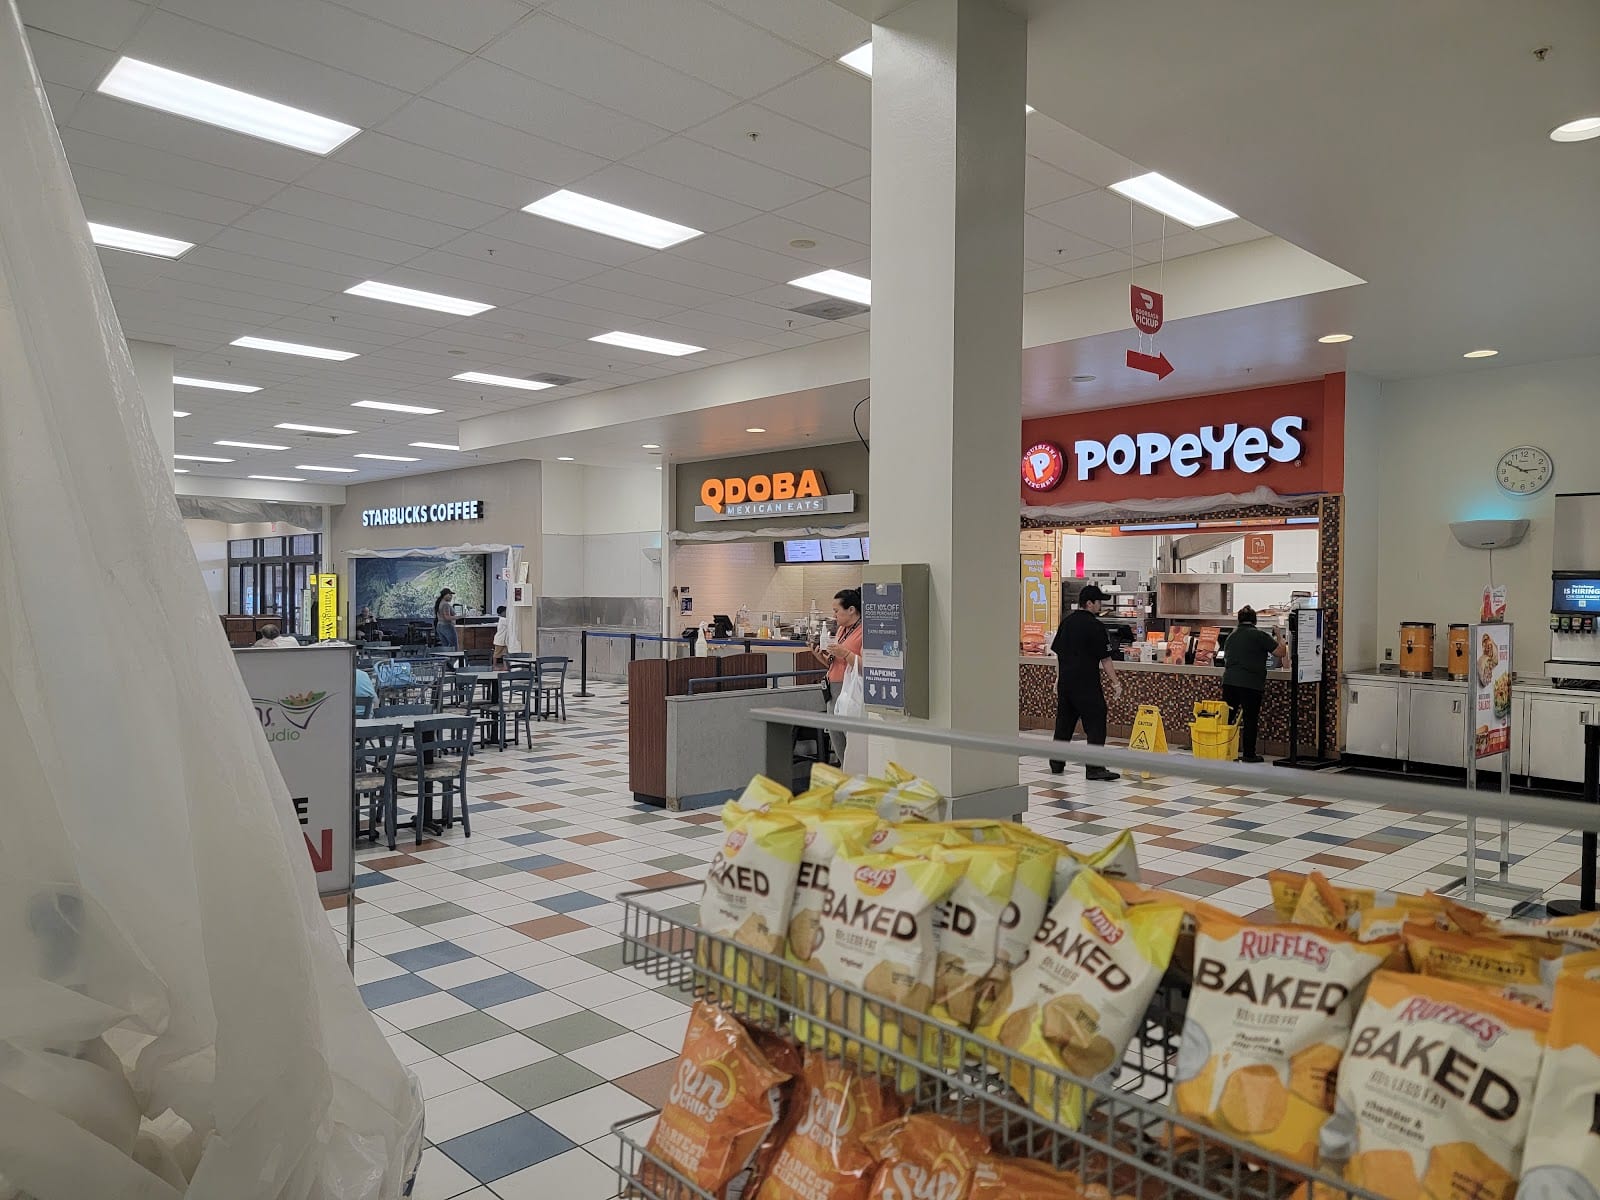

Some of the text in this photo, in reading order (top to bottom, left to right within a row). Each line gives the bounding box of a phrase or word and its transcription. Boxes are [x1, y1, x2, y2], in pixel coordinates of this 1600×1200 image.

[1135, 314, 1159, 328] PICKUP
[1023, 444, 1057, 460] LOUISIANA
[701, 469, 822, 514] QDOBA
[1024, 475, 1055, 489] KITCHEN
[362, 500, 479, 527] STARBUCKS COFFEE
[727, 500, 820, 515] MEXICAN EATS
[865, 603, 876, 611] GET
[869, 669, 897, 678] NAPKINS
[266, 727, 300, 743] udio
[855, 865, 895, 889] Lay's
[820, 889, 919, 943] BAKED
[1033, 917, 1132, 993] BAKED
[1239, 930, 1329, 966] RUFFLES
[1196, 957, 1349, 1017] BAKED
[1397, 996, 1502, 1042] RUFFLES
[669, 1058, 732, 1110] Sun
[1350, 1026, 1521, 1122] BAKED
[680, 1093, 719, 1124] CHIPS
[1365, 1100, 1412, 1123] cheddar
[658, 1118, 707, 1158] HARVEST
[1387, 1118, 1426, 1142] cream
